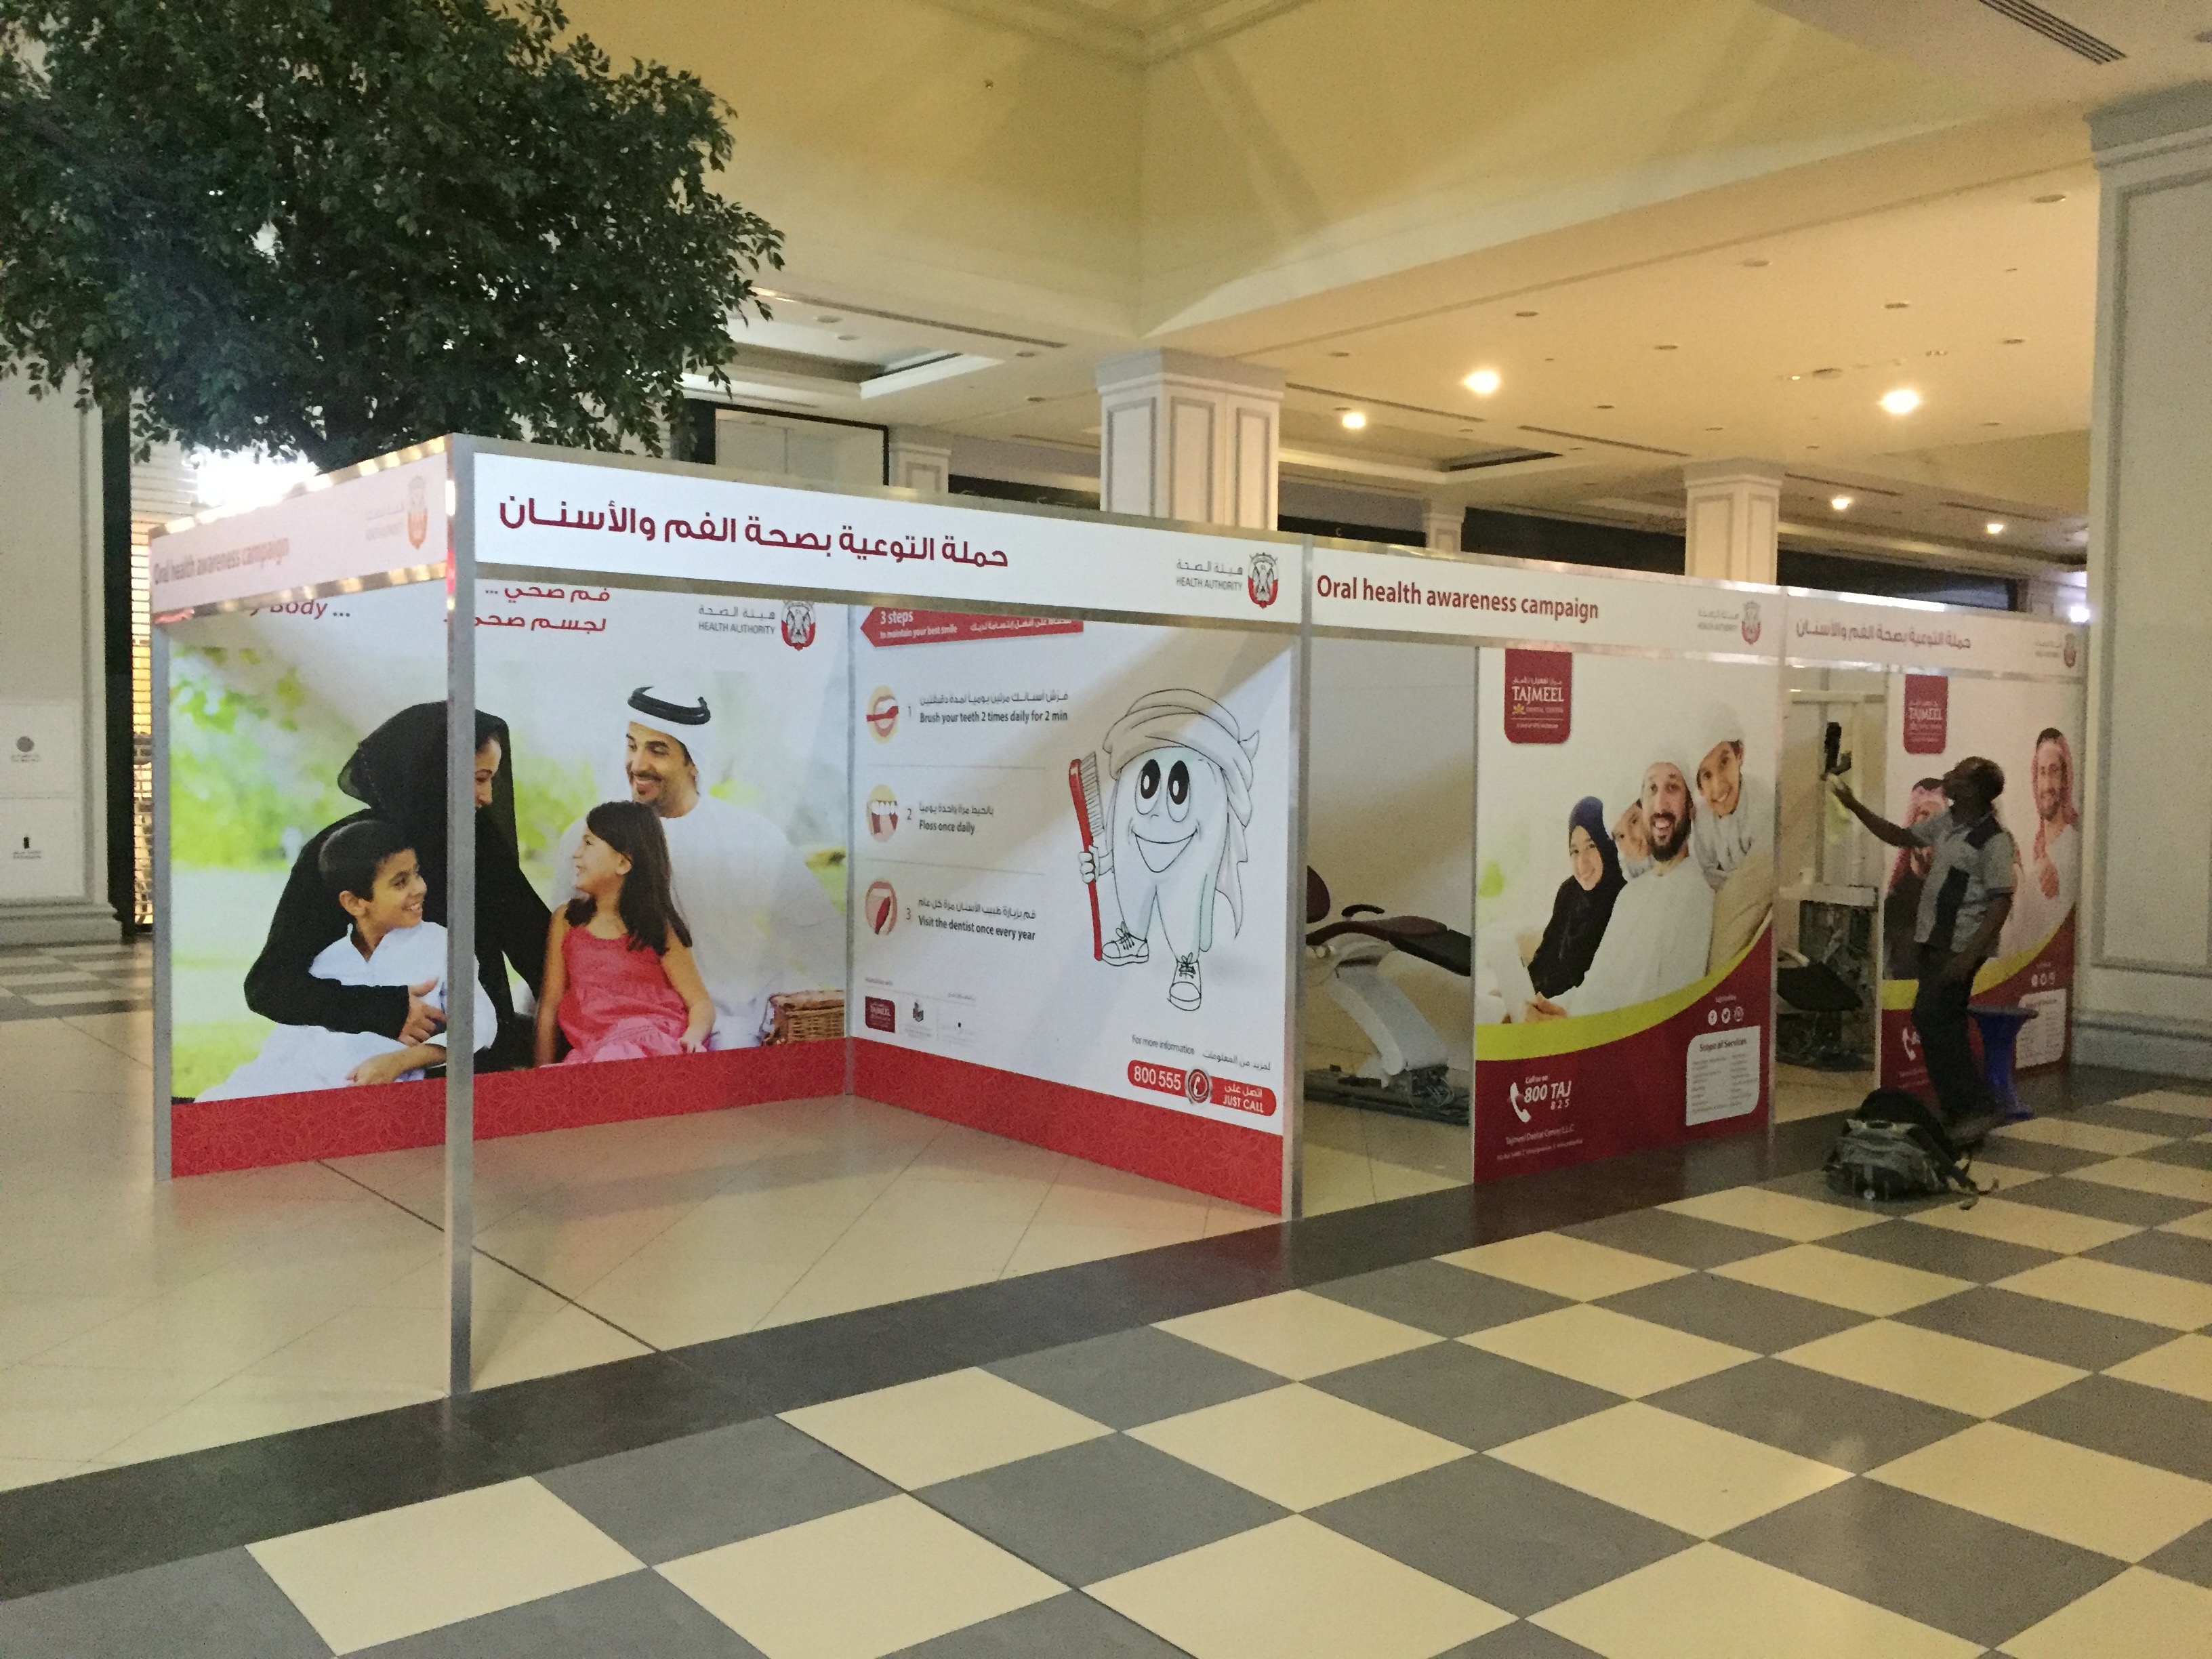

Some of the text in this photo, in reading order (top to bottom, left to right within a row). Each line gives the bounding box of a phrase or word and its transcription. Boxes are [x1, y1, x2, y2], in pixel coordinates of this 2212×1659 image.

[500, 495, 1008, 568] حملة التوعية بصحة الفم والأسنان
[1176, 577, 1243, 591] HEALTH AUTHORITY
[504, 586, 565, 603] صحي
[571, 588, 610, 602] فم
[1317, 575, 1599, 623] Oral health awareness campaign
[531, 617, 607, 635] لجسم
[699, 621, 775, 634] HEALTH AUTHORITY
[880, 611, 914, 627] 3 steps
[1511, 686, 1564, 705] TAJMEEL
[920, 710, 1068, 724] Brush your teeth 2 times daily for 2 min
[907, 808, 912, 821] 2
[919, 819, 975, 836] Floss once daily
[905, 907, 911, 920] 3
[918, 915, 1036, 941] Visit the dentist once every year
[1132, 1034, 1195, 1055] For more information
[1134, 1065, 1181, 1090] 800 555
[1525, 1080, 1572, 1103] 800 TAJ
[1223, 1094, 1265, 1113] JUST CALL
